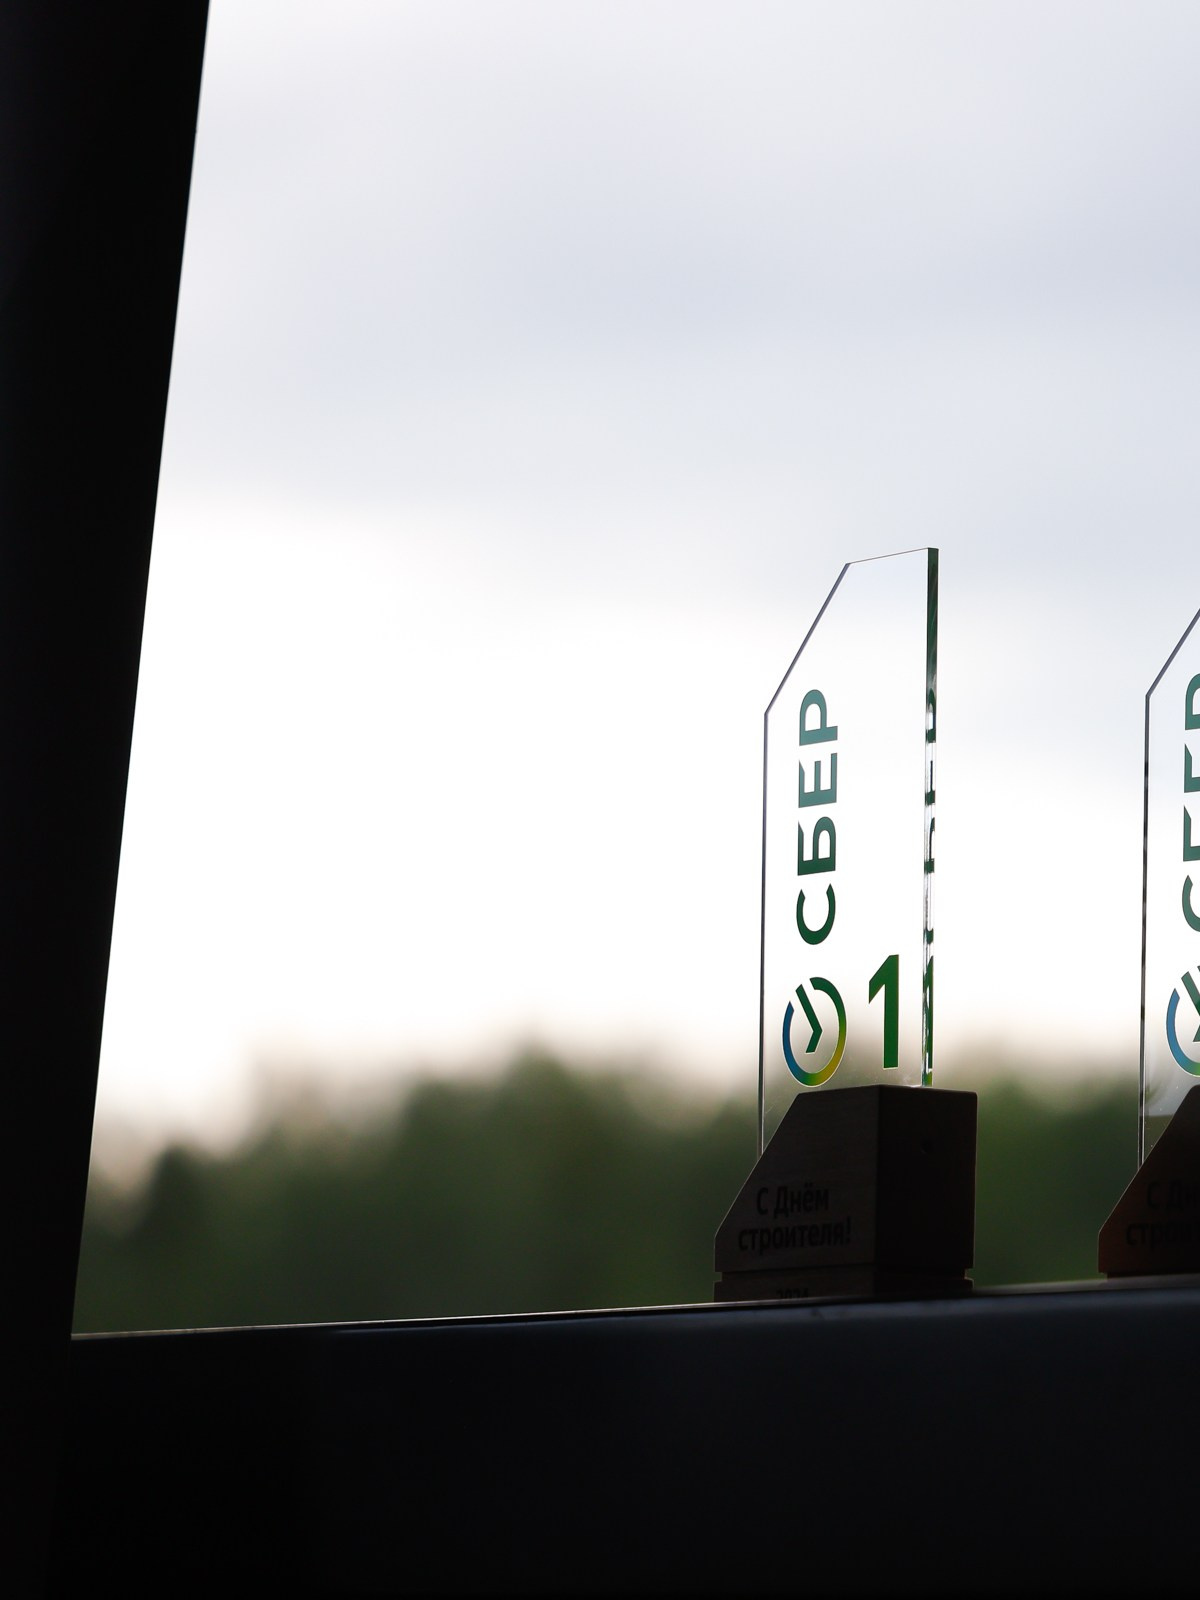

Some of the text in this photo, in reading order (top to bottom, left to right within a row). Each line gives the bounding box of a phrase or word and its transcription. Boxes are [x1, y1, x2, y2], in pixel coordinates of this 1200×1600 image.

[796, 688, 838, 945] СБЕР
[868, 954, 899, 1070] 1
[738, 1216, 852, 1256] строителя!
[756, 1182, 829, 1219] С Днём
